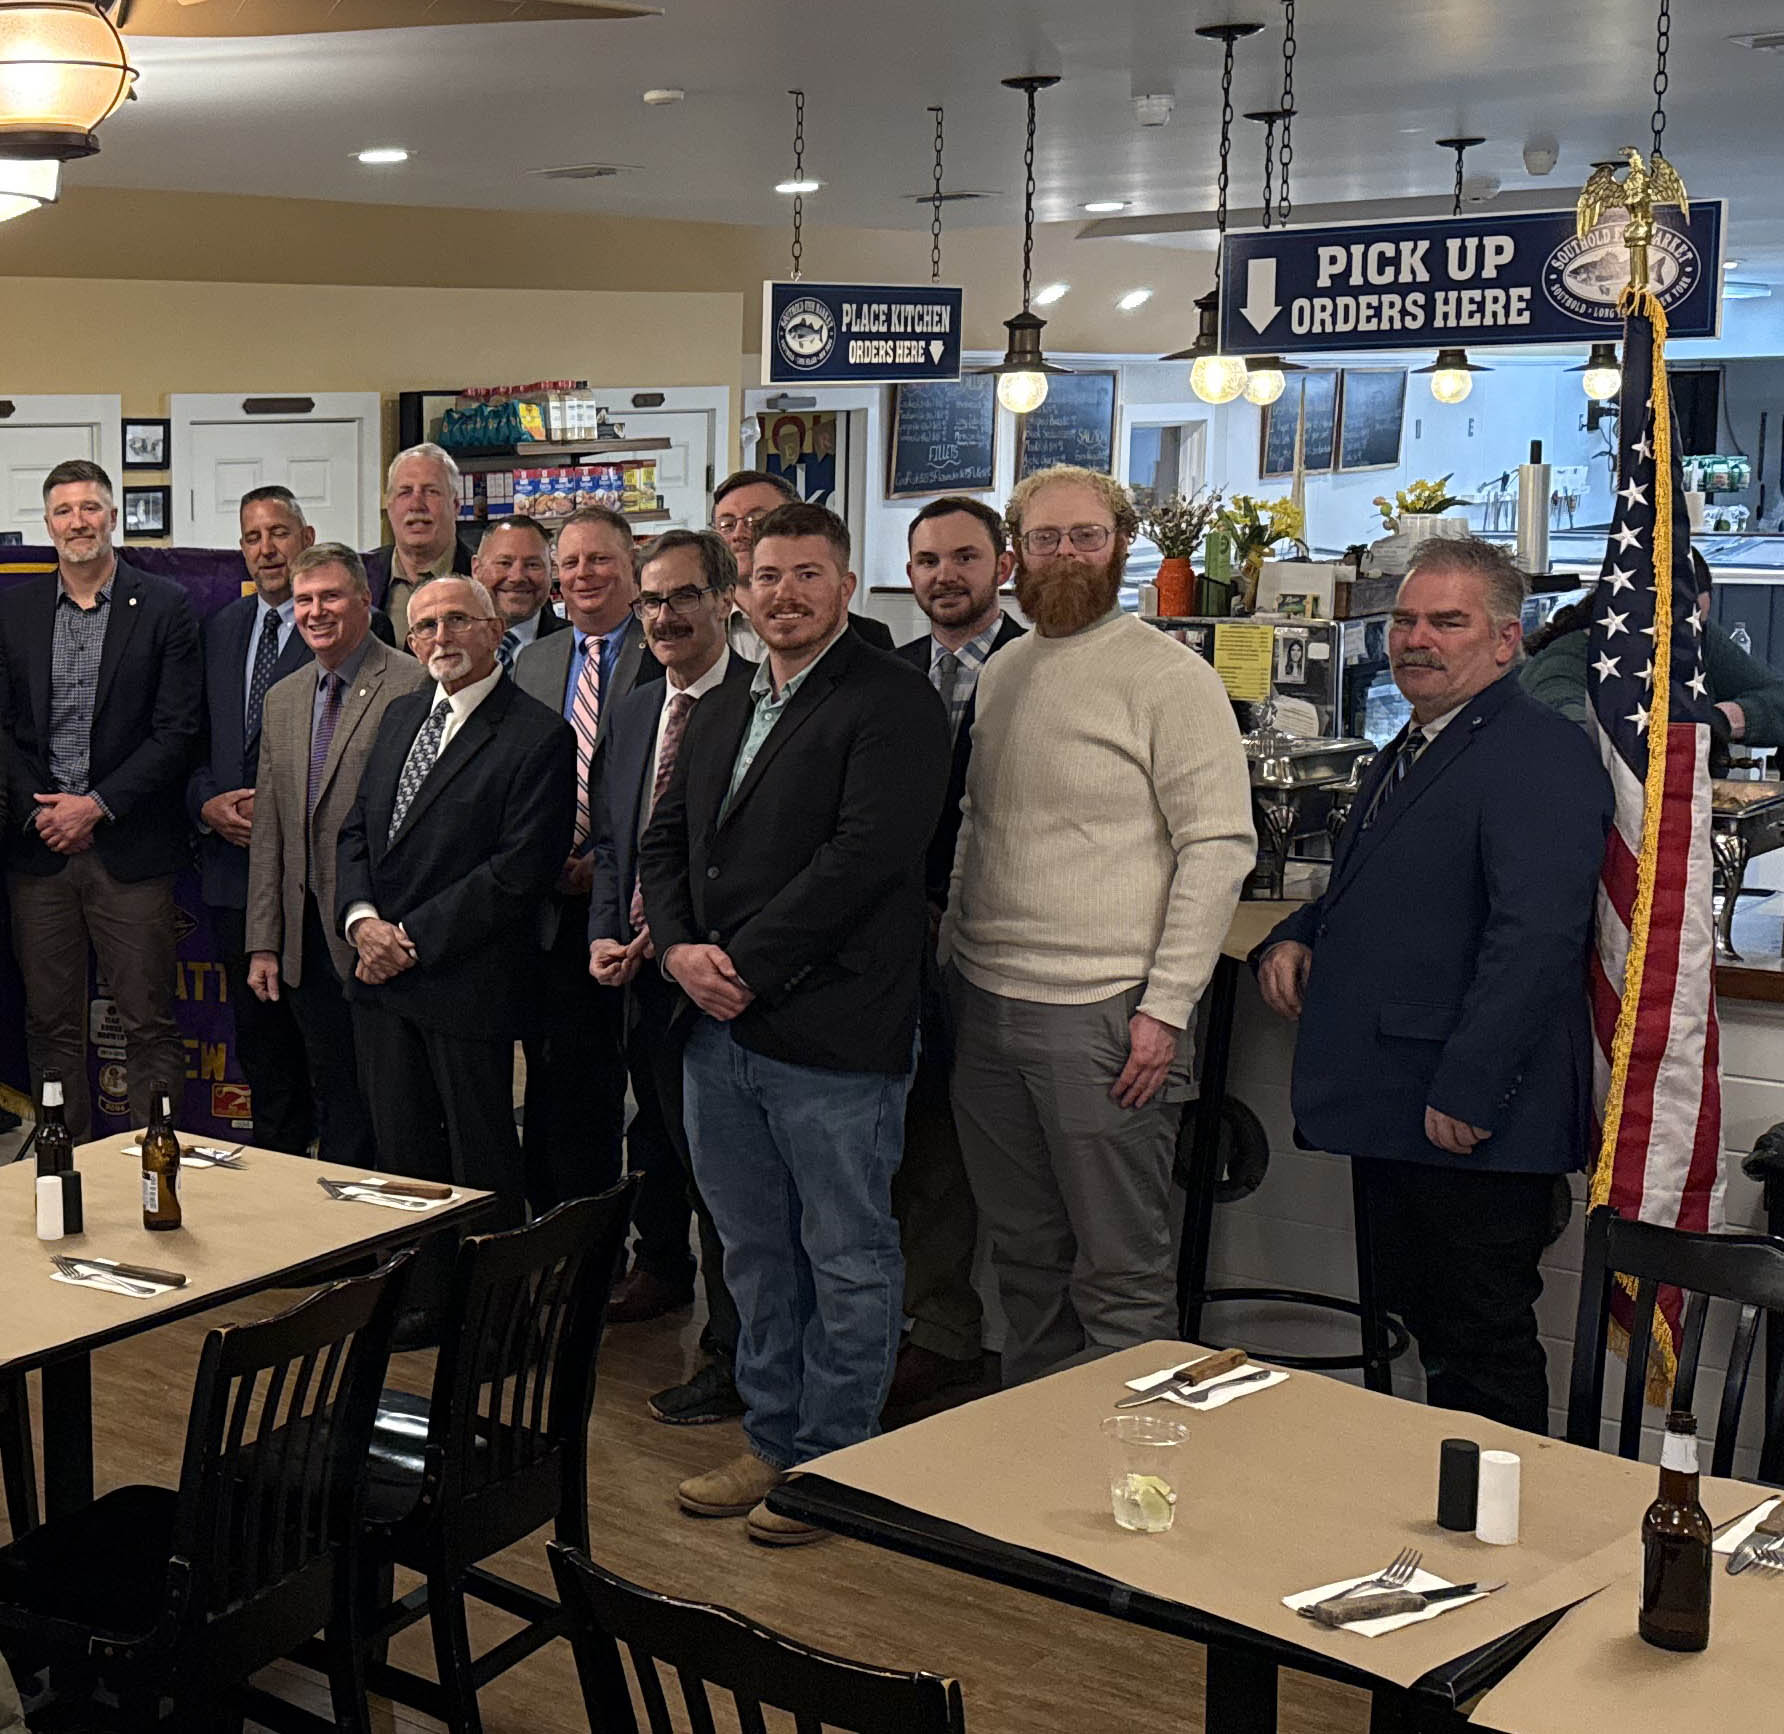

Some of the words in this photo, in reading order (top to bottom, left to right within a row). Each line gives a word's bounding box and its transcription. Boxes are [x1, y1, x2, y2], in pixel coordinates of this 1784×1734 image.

[1317, 240, 1430, 288] PICK
[1446, 235, 1515, 281] UP
[1551, 229, 1611, 271] SOUTHOLD
[1651, 231, 1693, 264] ARKET
[1291, 292, 1425, 335] ORDERS
[1434, 287, 1532, 328] HERE
[1550, 283, 1587, 314] SOUTHOLD
[1673, 277, 1692, 299] YORK
[842, 303, 887, 333] PLACE
[891, 304, 951, 333] KITCHEN
[849, 340, 894, 364] ORDERS
[895, 340, 926, 363] HERE
[928, 444, 959, 462] FILLETS
